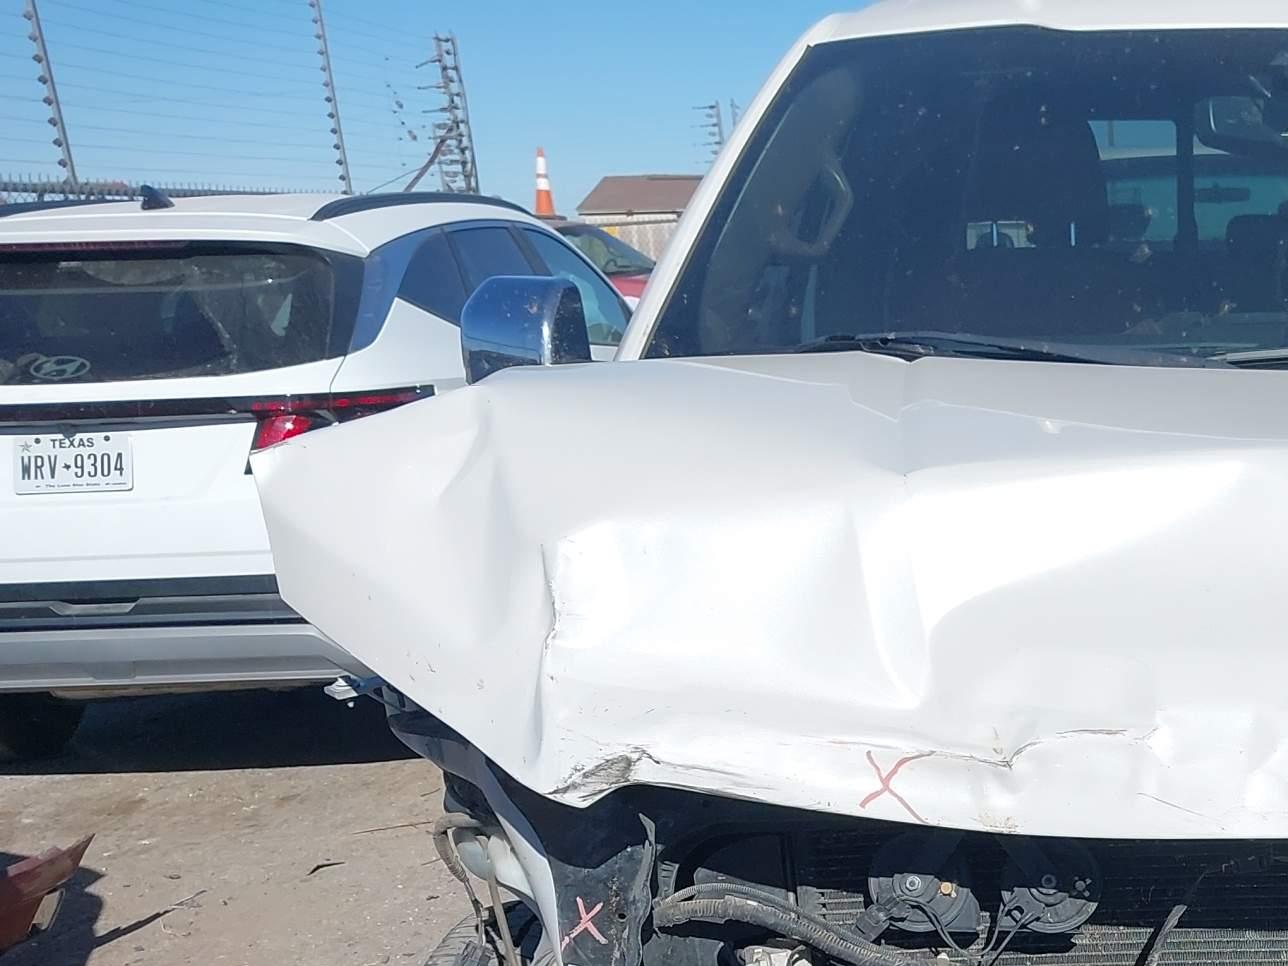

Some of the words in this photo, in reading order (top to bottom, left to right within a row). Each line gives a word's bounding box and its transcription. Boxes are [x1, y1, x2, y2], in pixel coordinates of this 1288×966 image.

[50, 438, 95, 449] TEXAS
[21, 454, 58, 480] WRV
[73, 452, 125, 478] 9304
